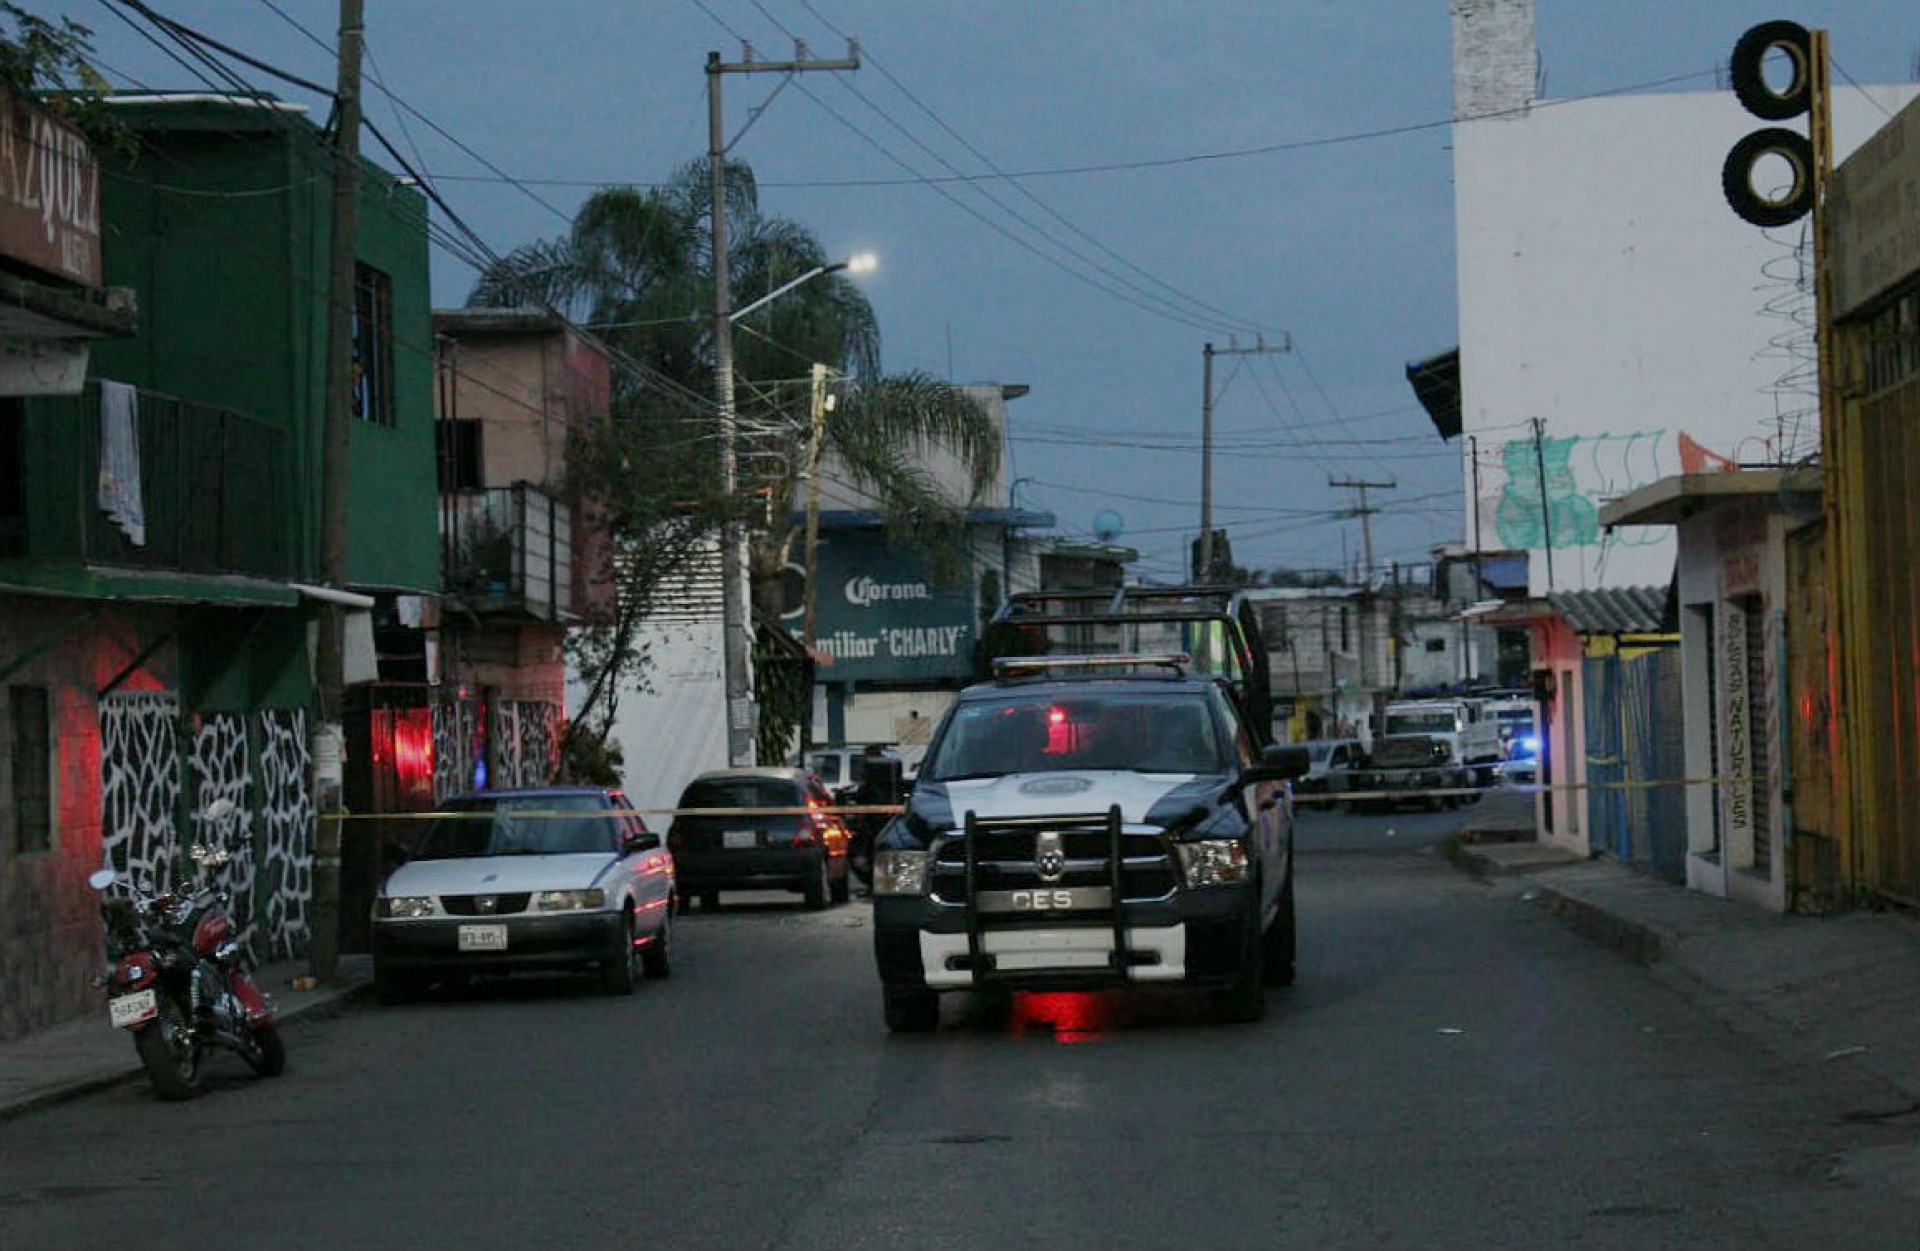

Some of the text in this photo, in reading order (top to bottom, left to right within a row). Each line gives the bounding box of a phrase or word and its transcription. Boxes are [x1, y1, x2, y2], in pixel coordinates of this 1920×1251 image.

[845, 576, 927, 607] Corona
[790, 628, 878, 659] miliar
[1012, 891, 1073, 910] CES
